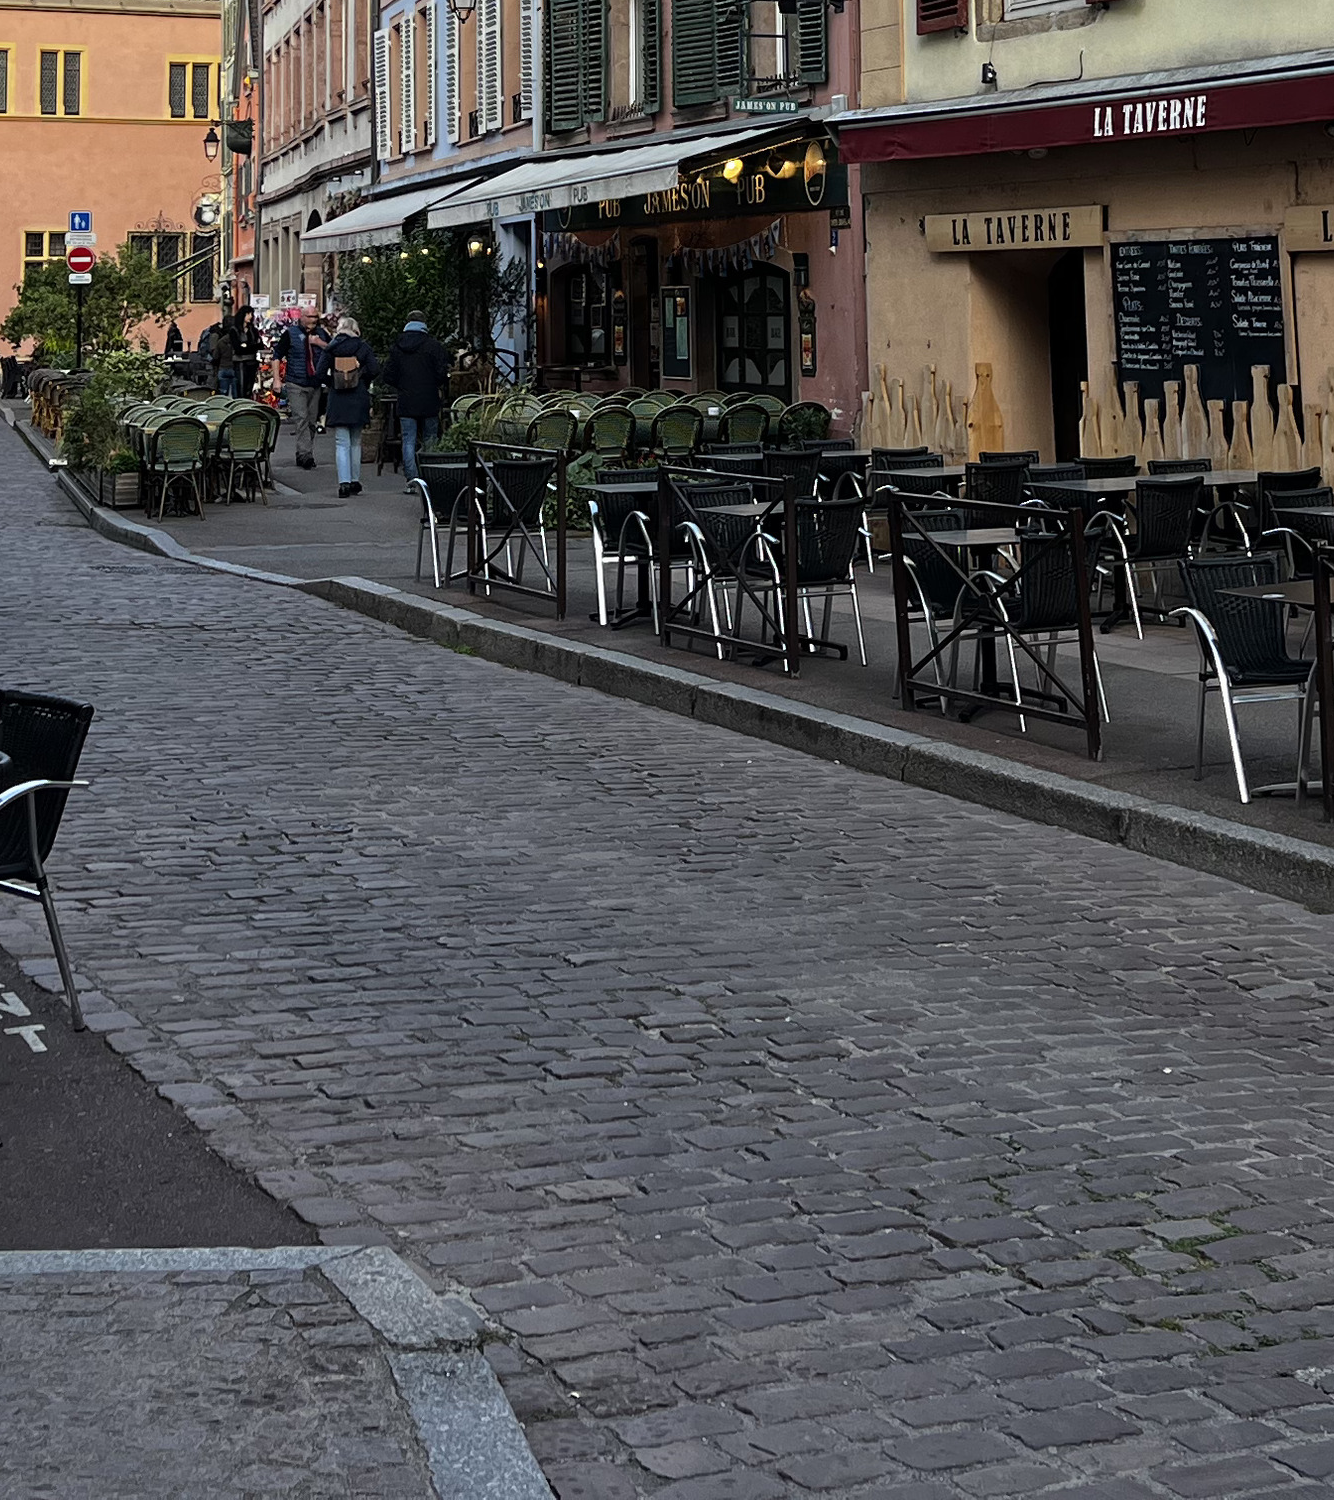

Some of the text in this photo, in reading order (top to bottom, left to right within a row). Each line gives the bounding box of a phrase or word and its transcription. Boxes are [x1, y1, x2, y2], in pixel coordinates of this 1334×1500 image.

[735, 100, 796, 111] JAMES'ON PUB
[1093, 95, 1207, 137] LA TAVERNE
[572, 185, 589, 203] PUB
[598, 173, 766, 219] PUB JAMES'ON PUB
[951, 211, 1071, 246] LA TAVERNE
